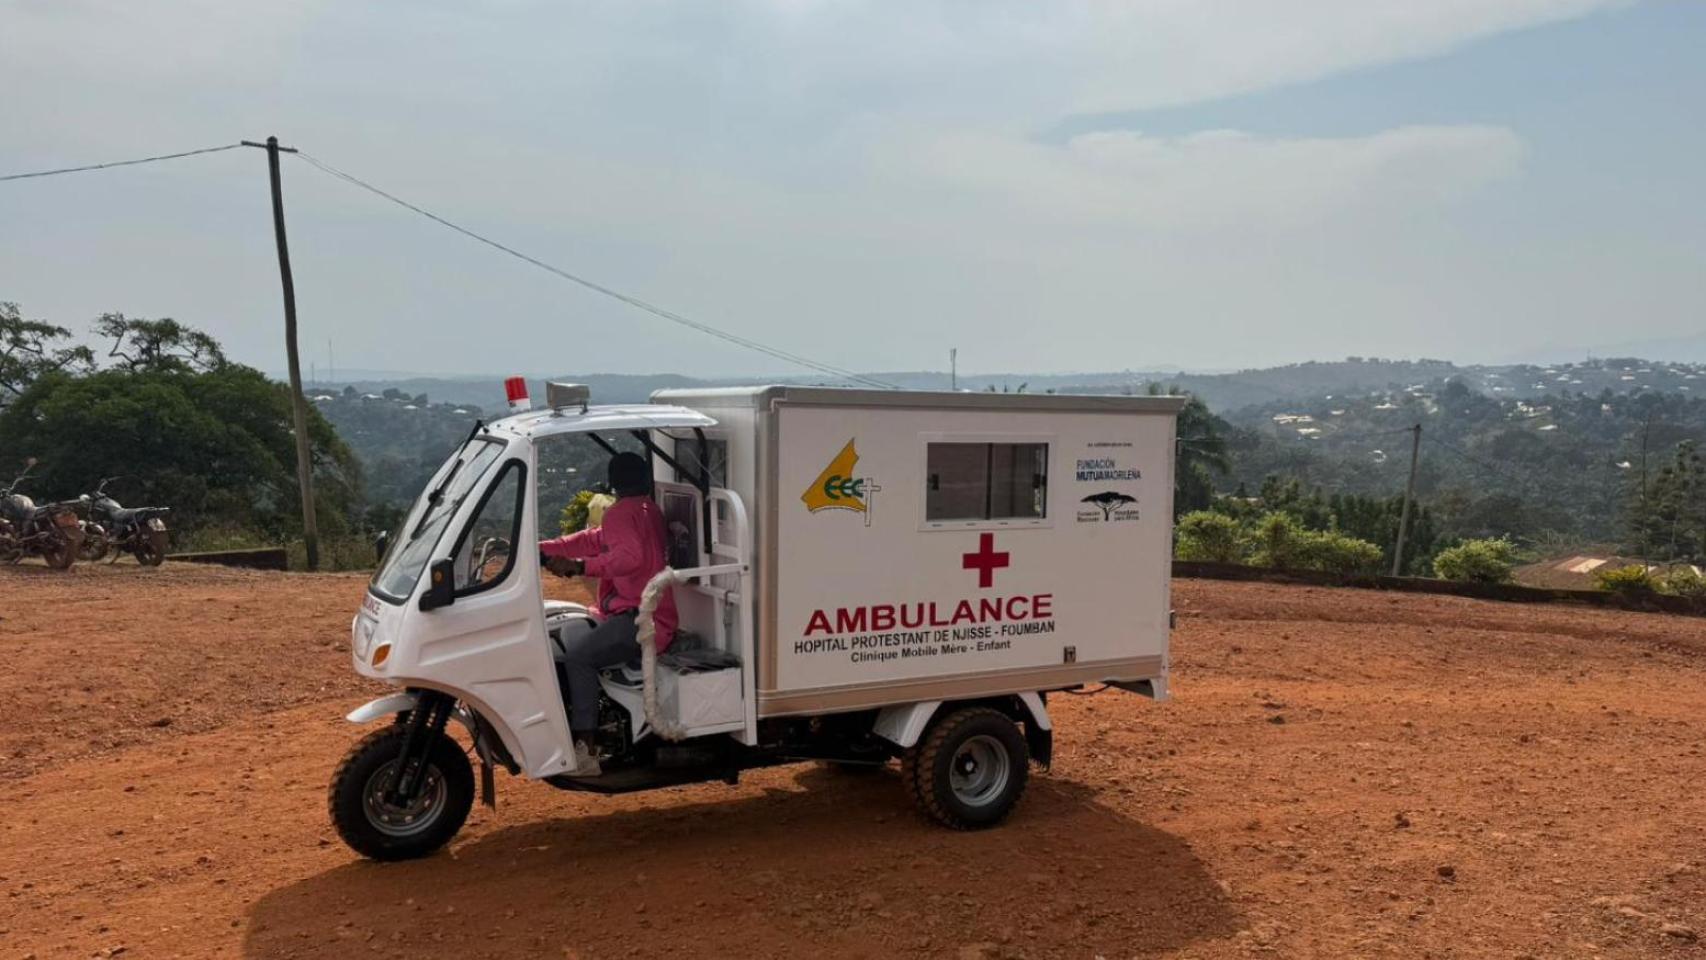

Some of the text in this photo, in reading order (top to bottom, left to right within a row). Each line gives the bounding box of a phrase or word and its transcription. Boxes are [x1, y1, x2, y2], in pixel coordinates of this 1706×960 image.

[803, 593, 1053, 636] AMBULANCE
[794, 638, 848, 654] HOPITAL
[851, 631, 932, 649] PROTESTANT
[934, 630, 949, 643] DE
[952, 626, 992, 641] NJISSE
[1001, 621, 1055, 636] FOUMBAN
[851, 650, 898, 662] Clinique
[901, 646, 938, 658] Mobile
[976, 640, 1011, 652] Enfant
